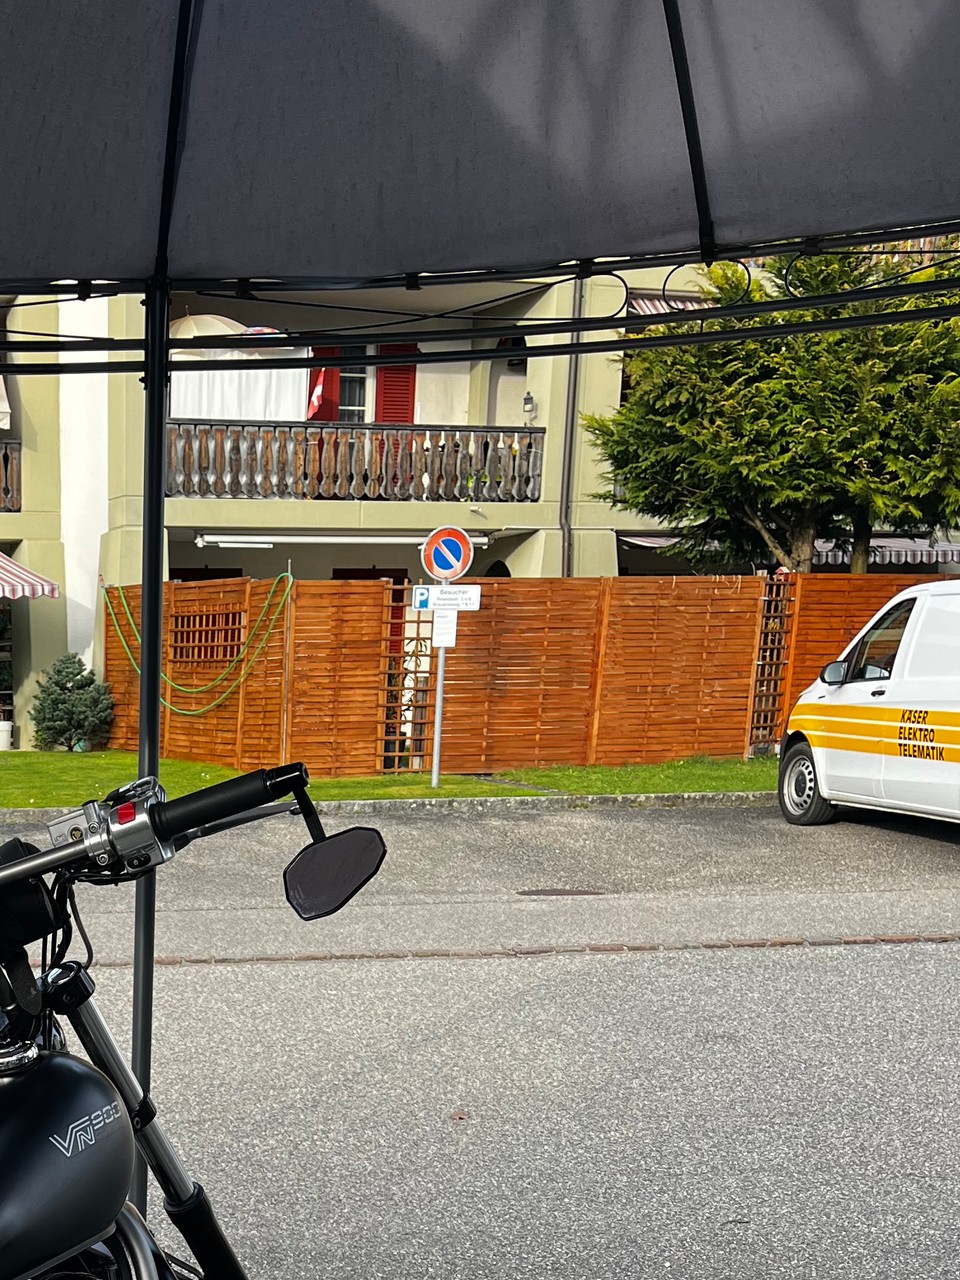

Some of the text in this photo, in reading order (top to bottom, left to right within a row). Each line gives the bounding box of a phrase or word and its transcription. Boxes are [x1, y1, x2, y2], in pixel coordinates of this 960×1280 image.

[415, 588, 429, 608] P
[439, 588, 469, 596] Besucher
[898, 726, 935, 743] ELEKTRO
[898, 743, 945, 761] TELEMATIK
